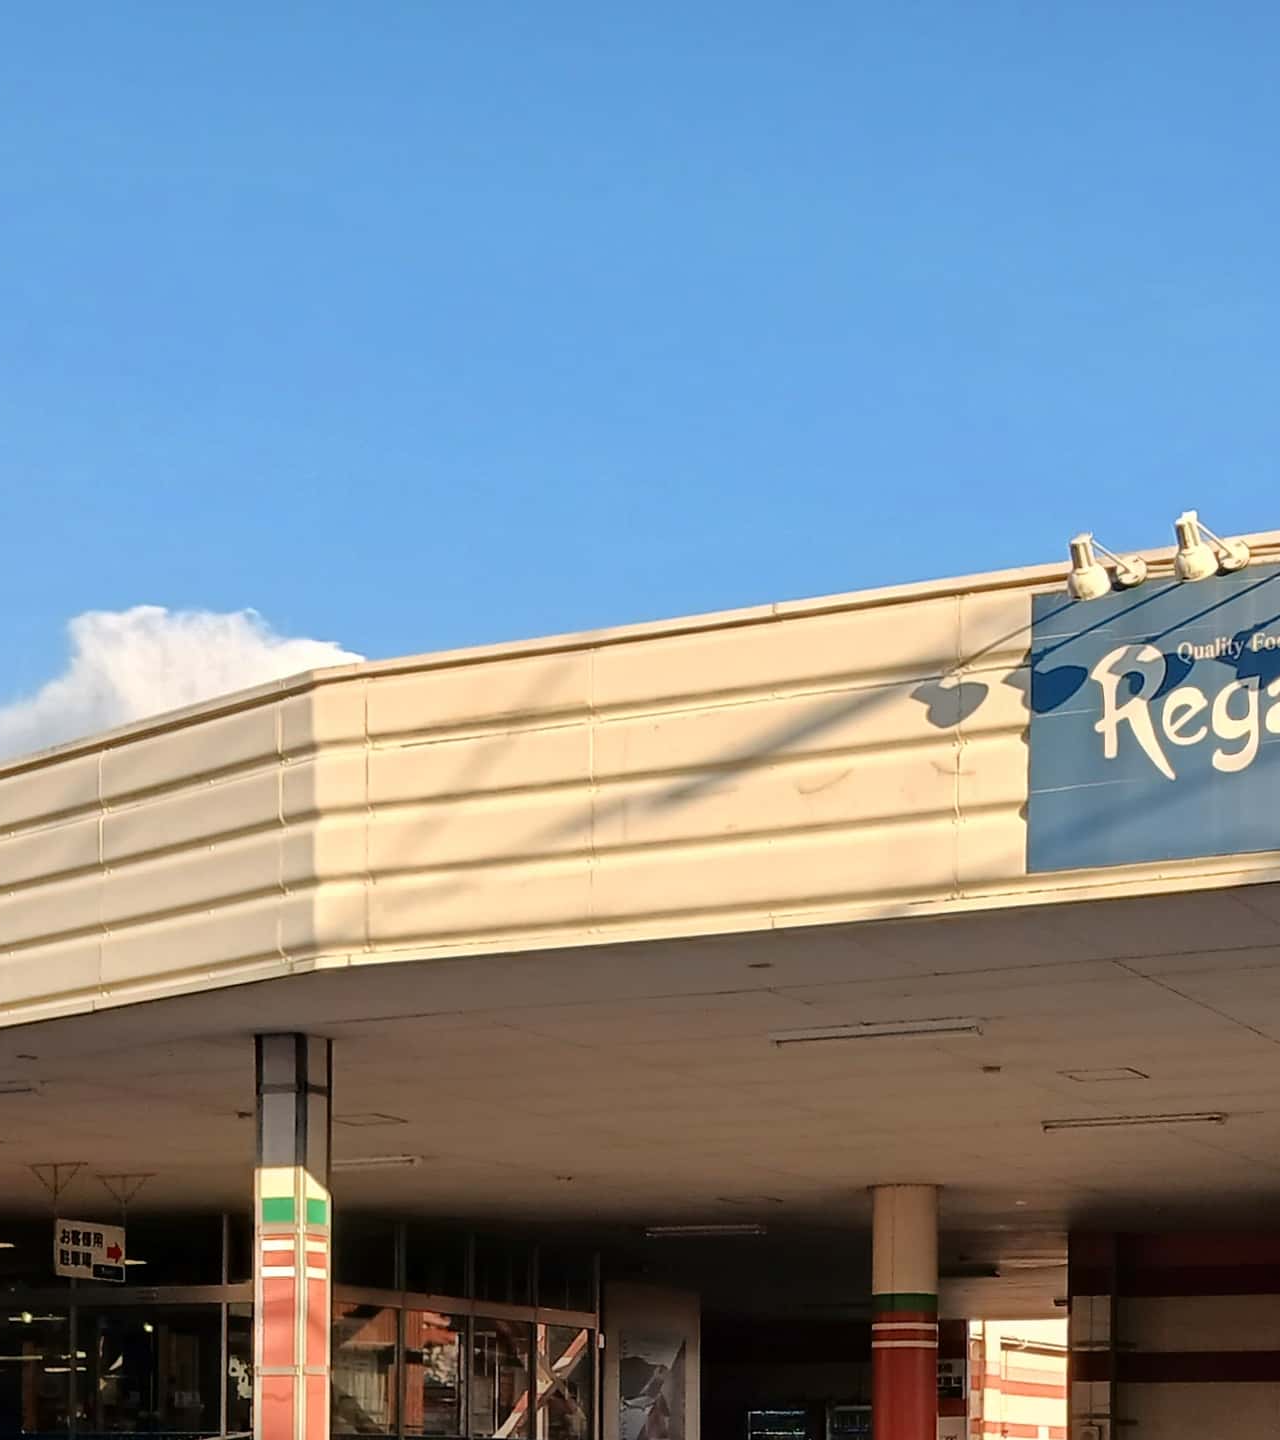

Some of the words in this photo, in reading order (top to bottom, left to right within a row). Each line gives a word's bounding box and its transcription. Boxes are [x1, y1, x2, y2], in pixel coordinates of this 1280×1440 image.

[1177, 640, 1244, 662] Quality
[60, 1228, 104, 1248] お客様用
[60, 1249, 92, 1268] 駐車場
